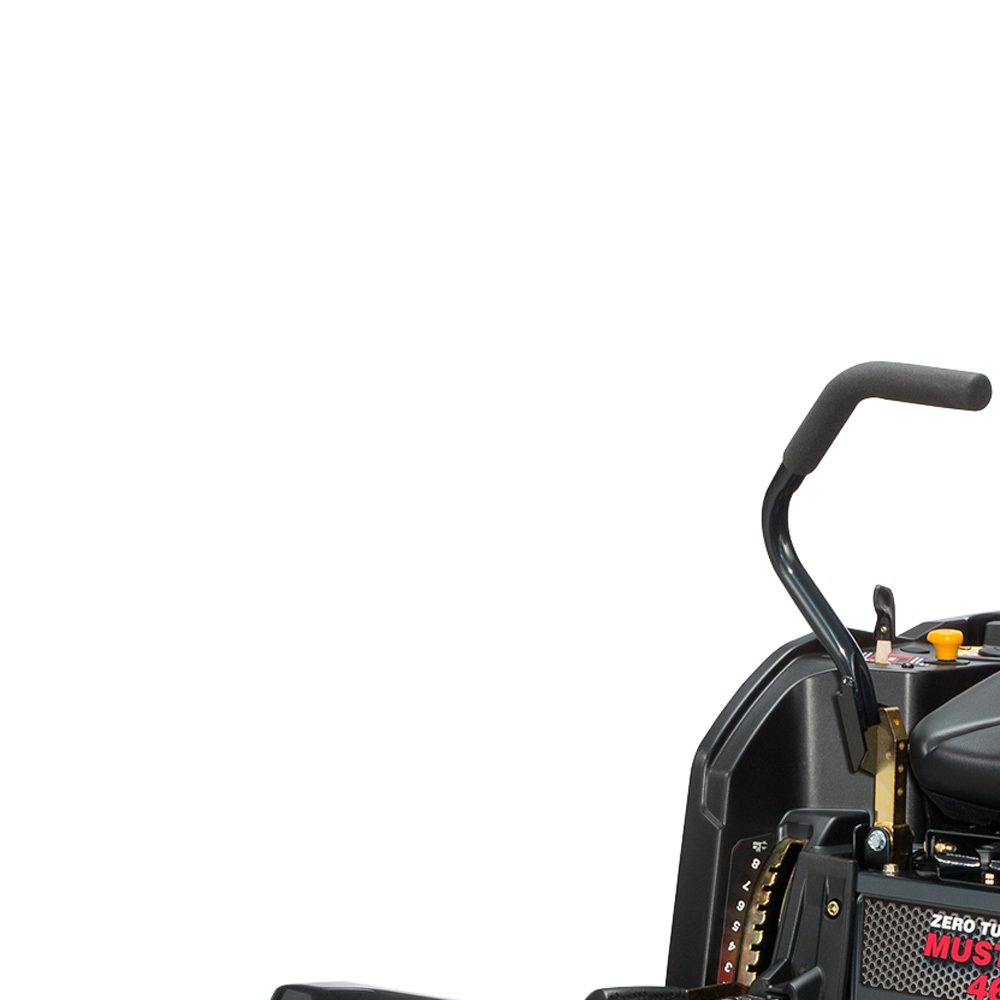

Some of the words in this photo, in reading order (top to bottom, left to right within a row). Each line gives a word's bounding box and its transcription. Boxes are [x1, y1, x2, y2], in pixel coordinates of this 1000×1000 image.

[751, 858, 761, 870] 8
[742, 880, 752, 892] 7
[736, 900, 746, 912] 6
[731, 920, 741, 933] 5
[930, 914, 976, 933] ZERO
[727, 940, 737, 952] 4
[723, 961, 733, 974] 3
